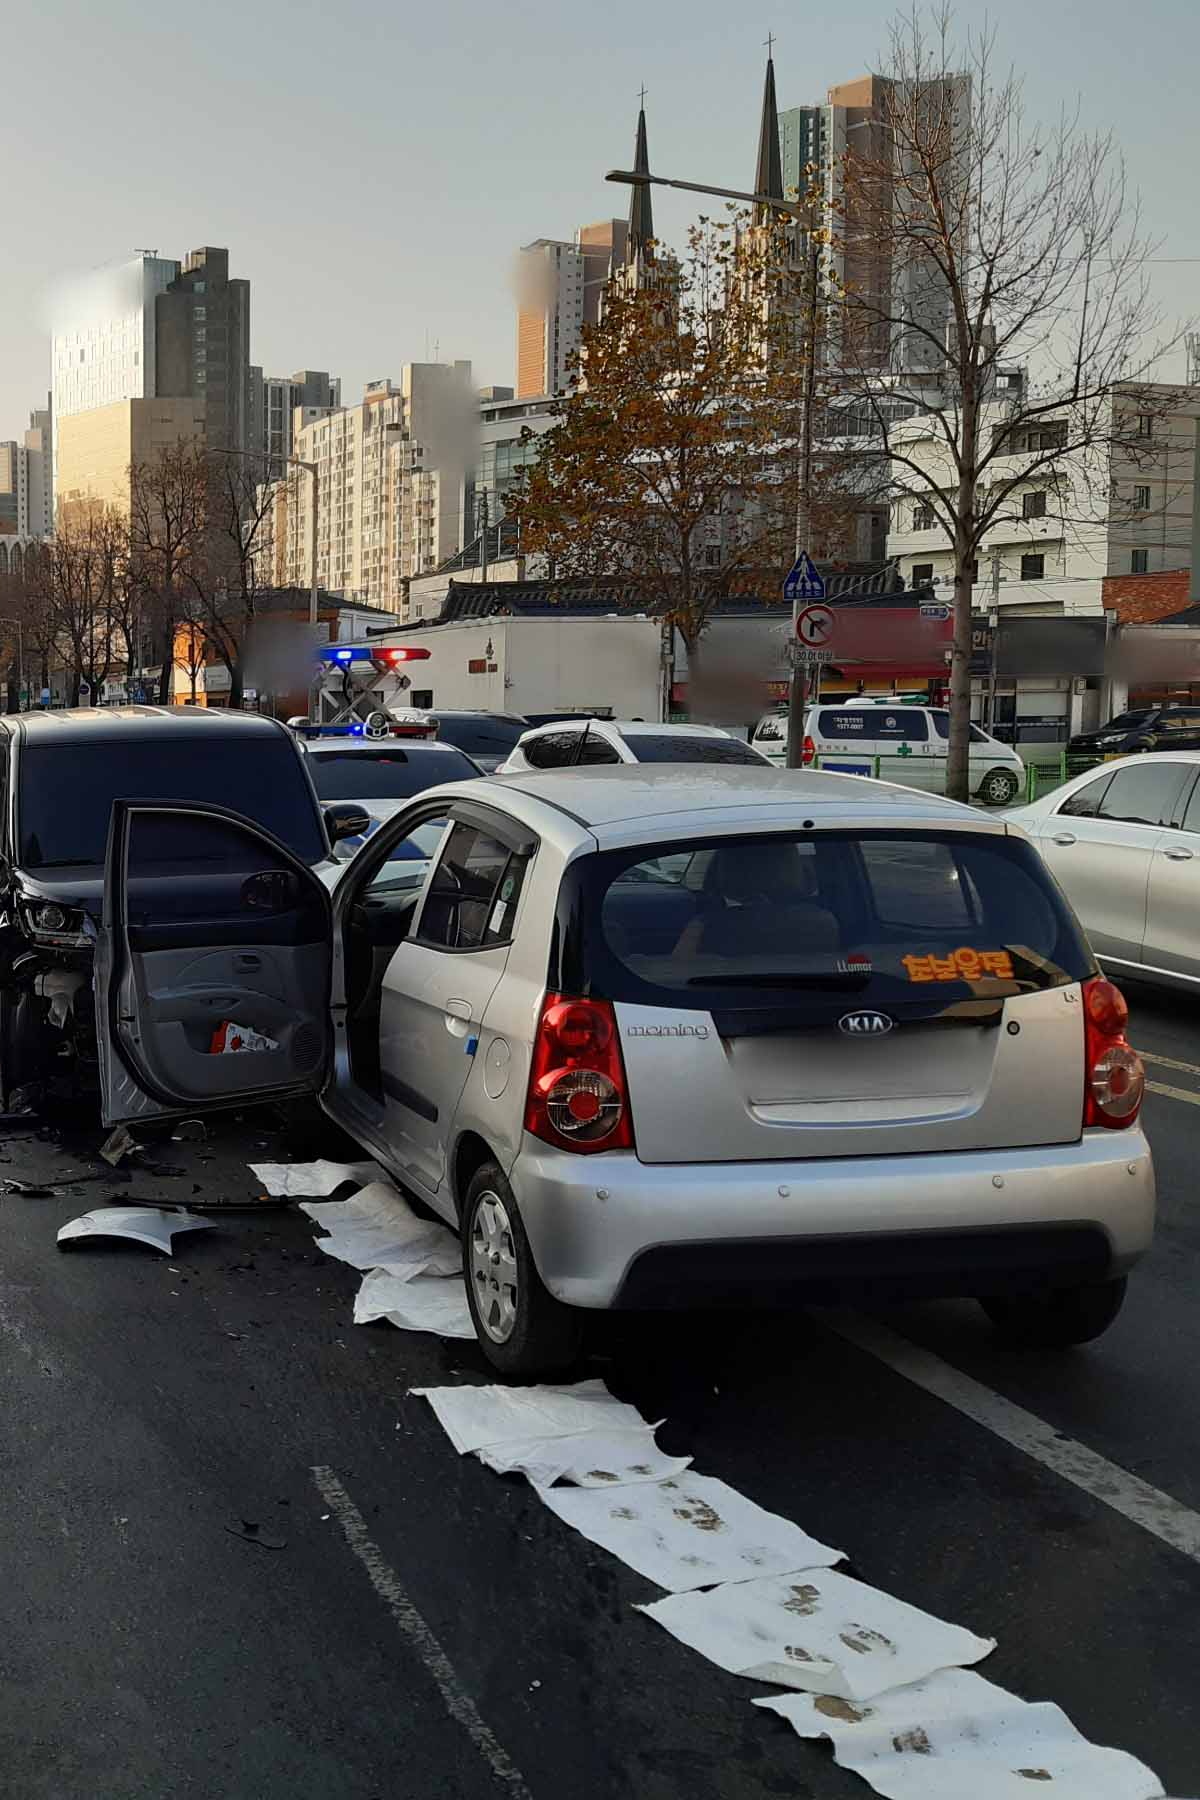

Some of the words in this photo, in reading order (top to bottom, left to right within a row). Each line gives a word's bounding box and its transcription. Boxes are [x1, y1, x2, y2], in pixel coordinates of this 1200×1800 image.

[902, 947, 1015, 983] 초보운전
[627, 1023, 709, 1040] morning
[847, 1017, 886, 1032] KIA
